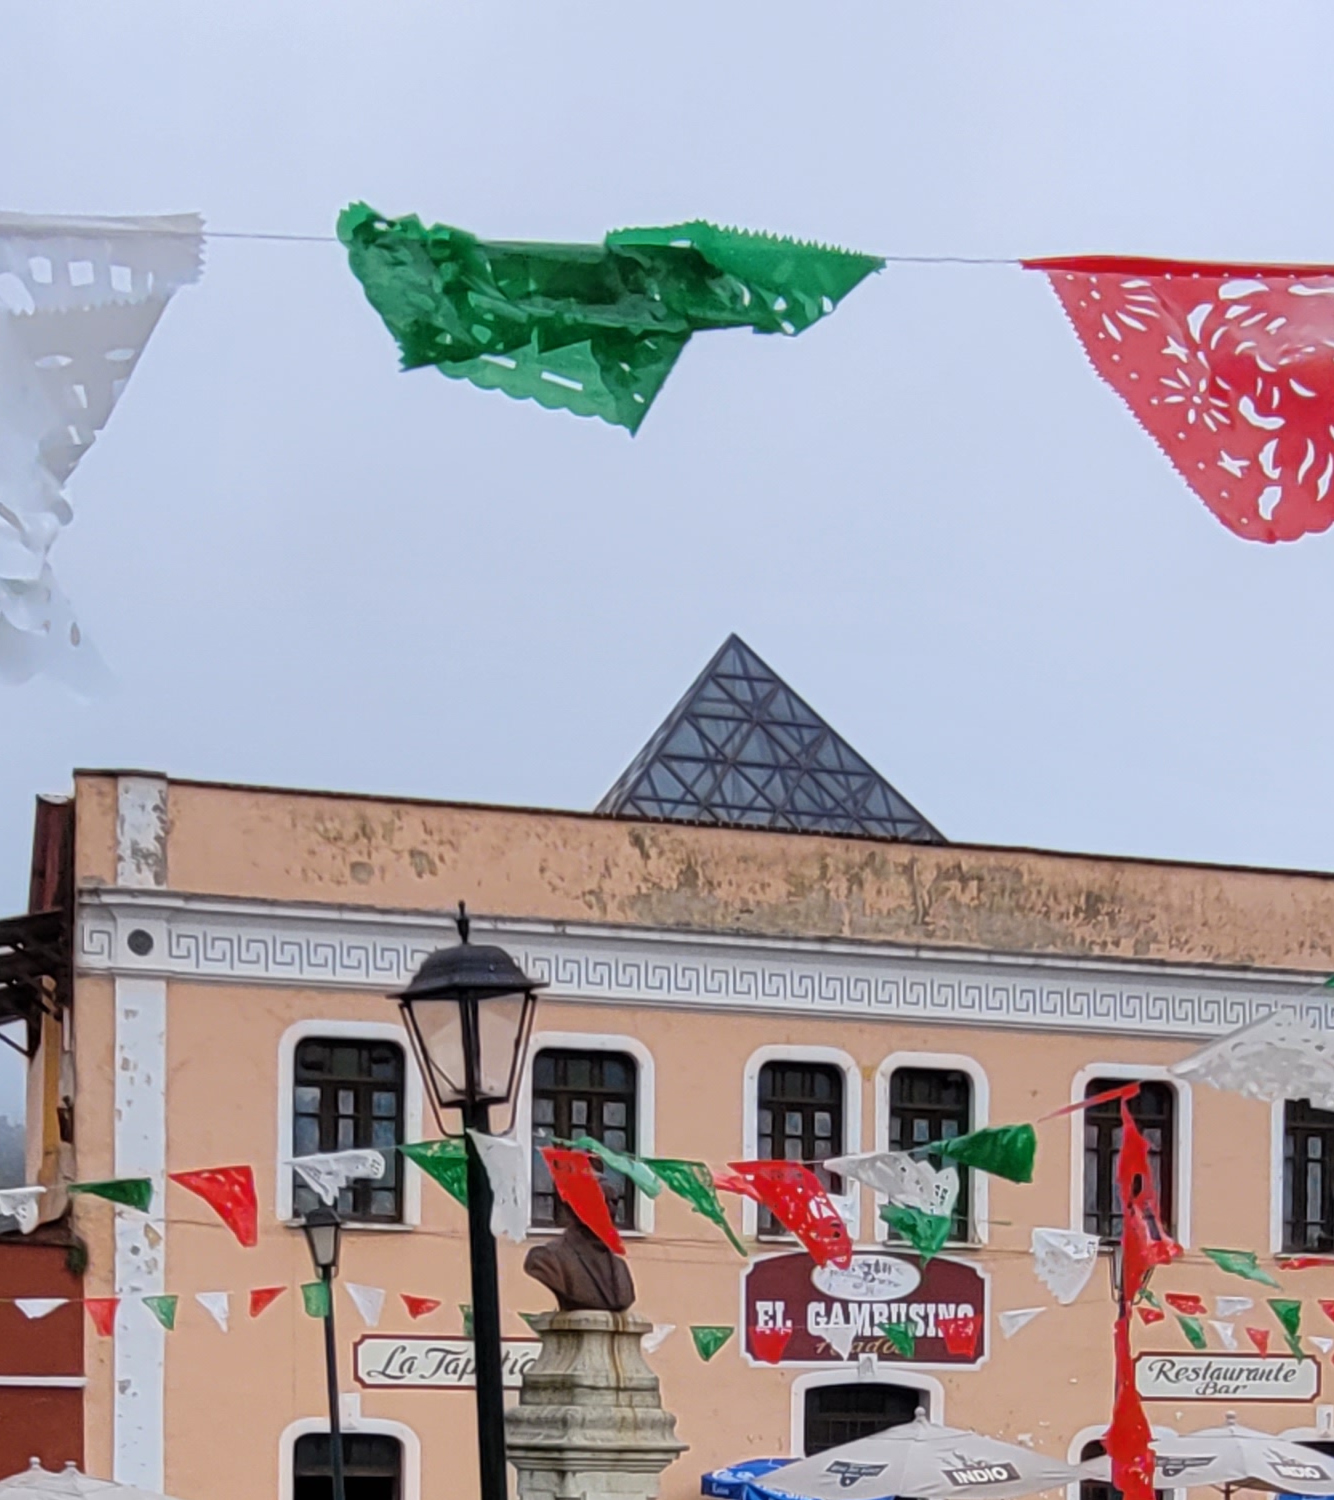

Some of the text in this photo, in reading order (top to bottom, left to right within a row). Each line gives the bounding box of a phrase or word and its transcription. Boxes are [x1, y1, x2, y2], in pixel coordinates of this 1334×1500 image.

[366, 1345, 538, 1382] La Taptía
[1148, 1358, 1297, 1384] Restaurante
[1195, 1381, 1248, 1396] Bar
[953, 1465, 1009, 1485] INDIO
